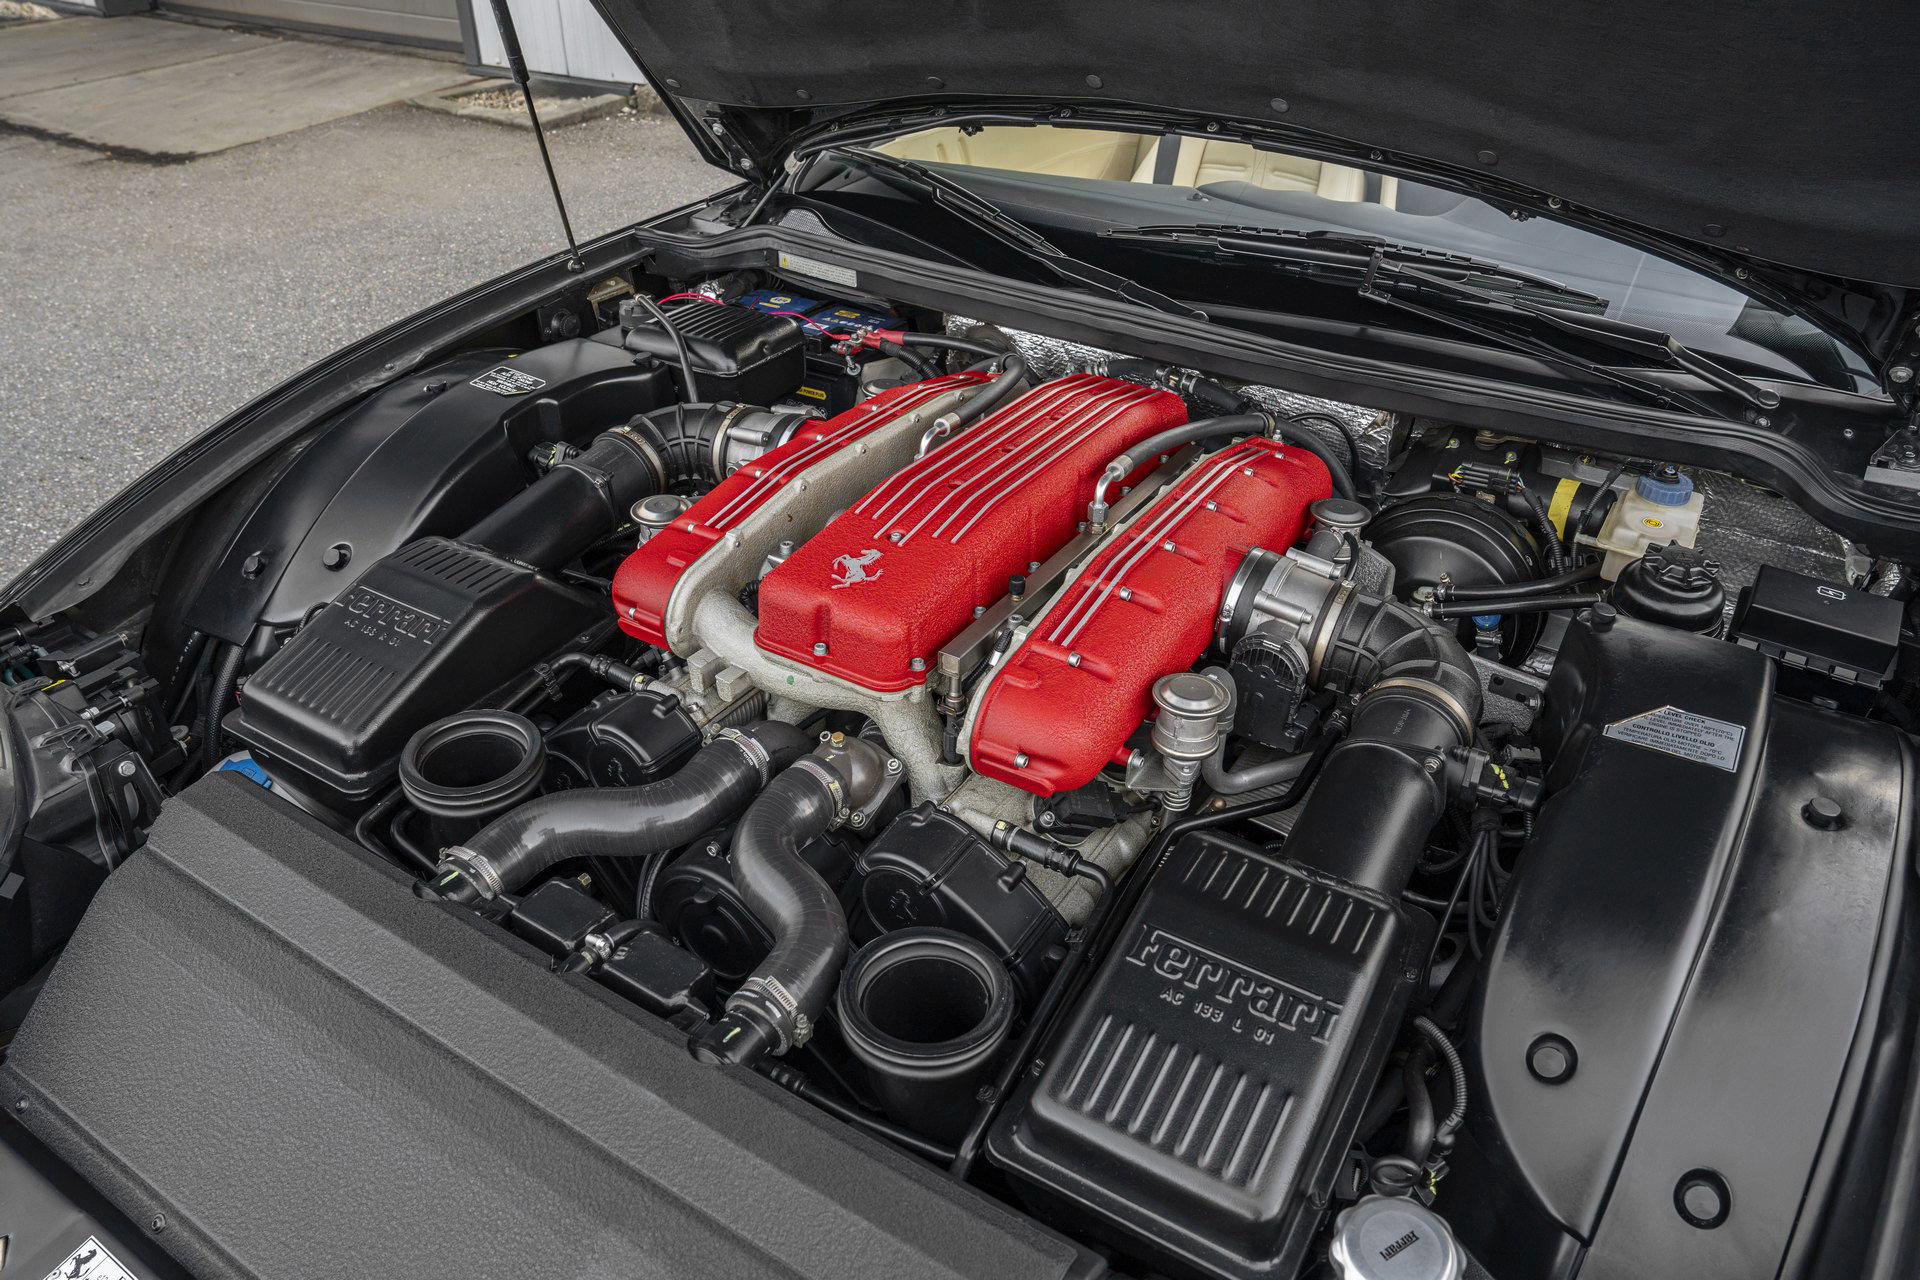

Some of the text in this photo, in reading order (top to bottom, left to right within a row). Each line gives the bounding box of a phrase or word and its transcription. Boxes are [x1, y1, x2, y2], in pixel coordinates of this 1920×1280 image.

[334, 585, 452, 646] Ferrari
[1632, 723, 1716, 748] CONTROLLO LIVELLO OLIO
[1663, 710, 1706, 724] LEVEL CHECK
[1126, 924, 1343, 1046] Ferrari
[1159, 986, 1275, 1046] AC 133 L 01
